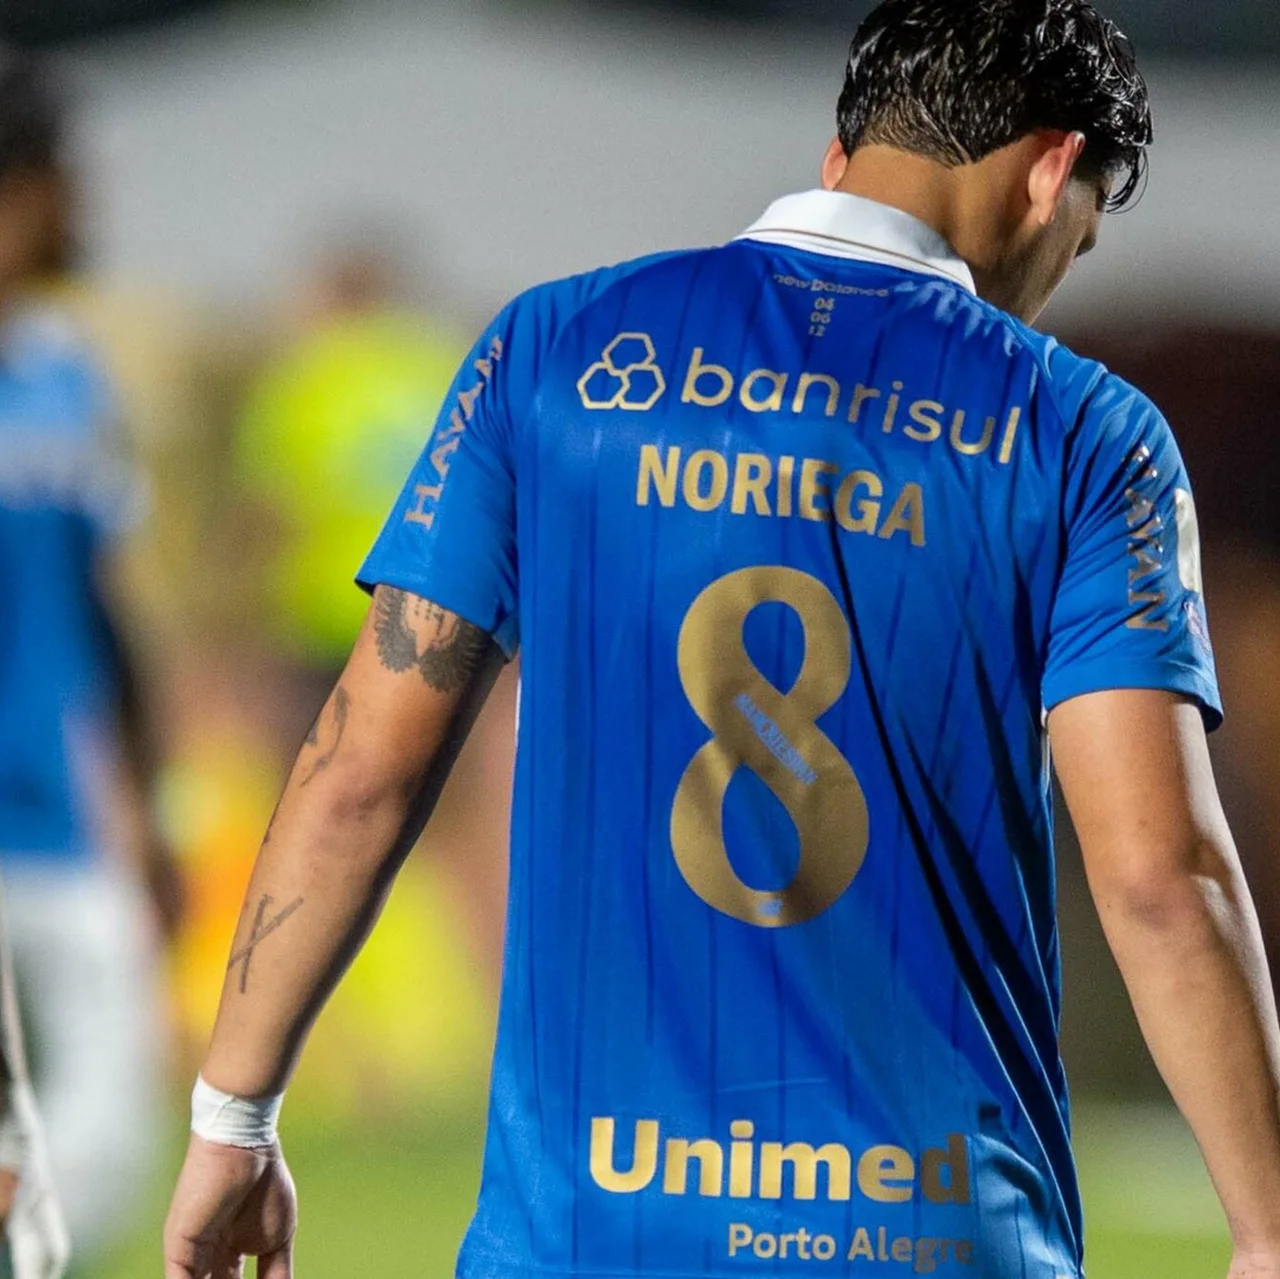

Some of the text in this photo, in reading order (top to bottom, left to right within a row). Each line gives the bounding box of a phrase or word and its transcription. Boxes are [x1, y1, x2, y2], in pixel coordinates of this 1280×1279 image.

[680, 347, 1021, 464] banrisul
[636, 444, 927, 548] NORIEGA
[670, 565, 870, 928] 8
[589, 1116, 972, 1206] Unimed
[728, 1223, 975, 1274] Porto Alegre
